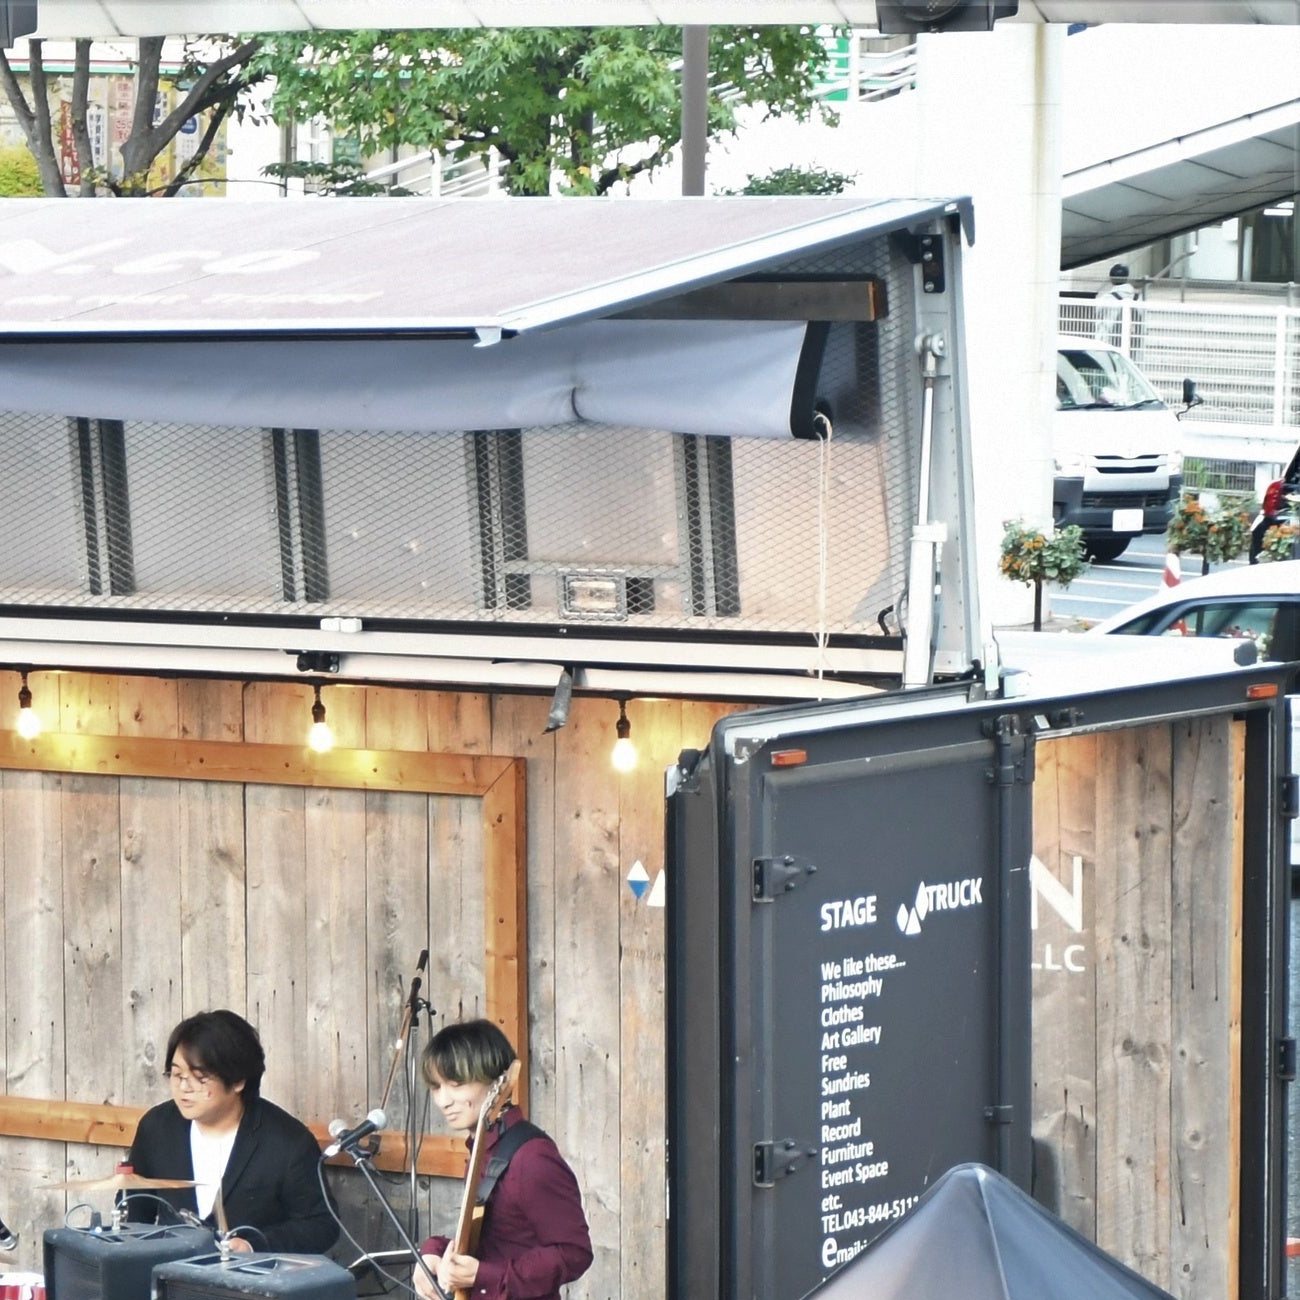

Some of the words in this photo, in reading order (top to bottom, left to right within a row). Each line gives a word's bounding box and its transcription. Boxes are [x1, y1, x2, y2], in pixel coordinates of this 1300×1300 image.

[821, 895, 878, 931] STAGE
[925, 877, 983, 912] TRUCK
[821, 961, 841, 981] We
[843, 957, 864, 978] like
[865, 953, 907, 974] these...
[1031, 943, 1086, 973] LC
[821, 975, 883, 1004] Philosophy
[821, 1004, 864, 1027] Clothes
[821, 1032, 840, 1051] Art
[841, 1024, 882, 1047] Gallery
[821, 1054, 848, 1073] Free
[821, 1071, 871, 1096] Sundries
[821, 1099, 851, 1121] Plant
[821, 1117, 862, 1143] Record
[821, 1141, 874, 1166] Furniture
[821, 1167, 854, 1189] Event
[855, 1161, 889, 1184] Space
[821, 1194, 843, 1212] etc.
